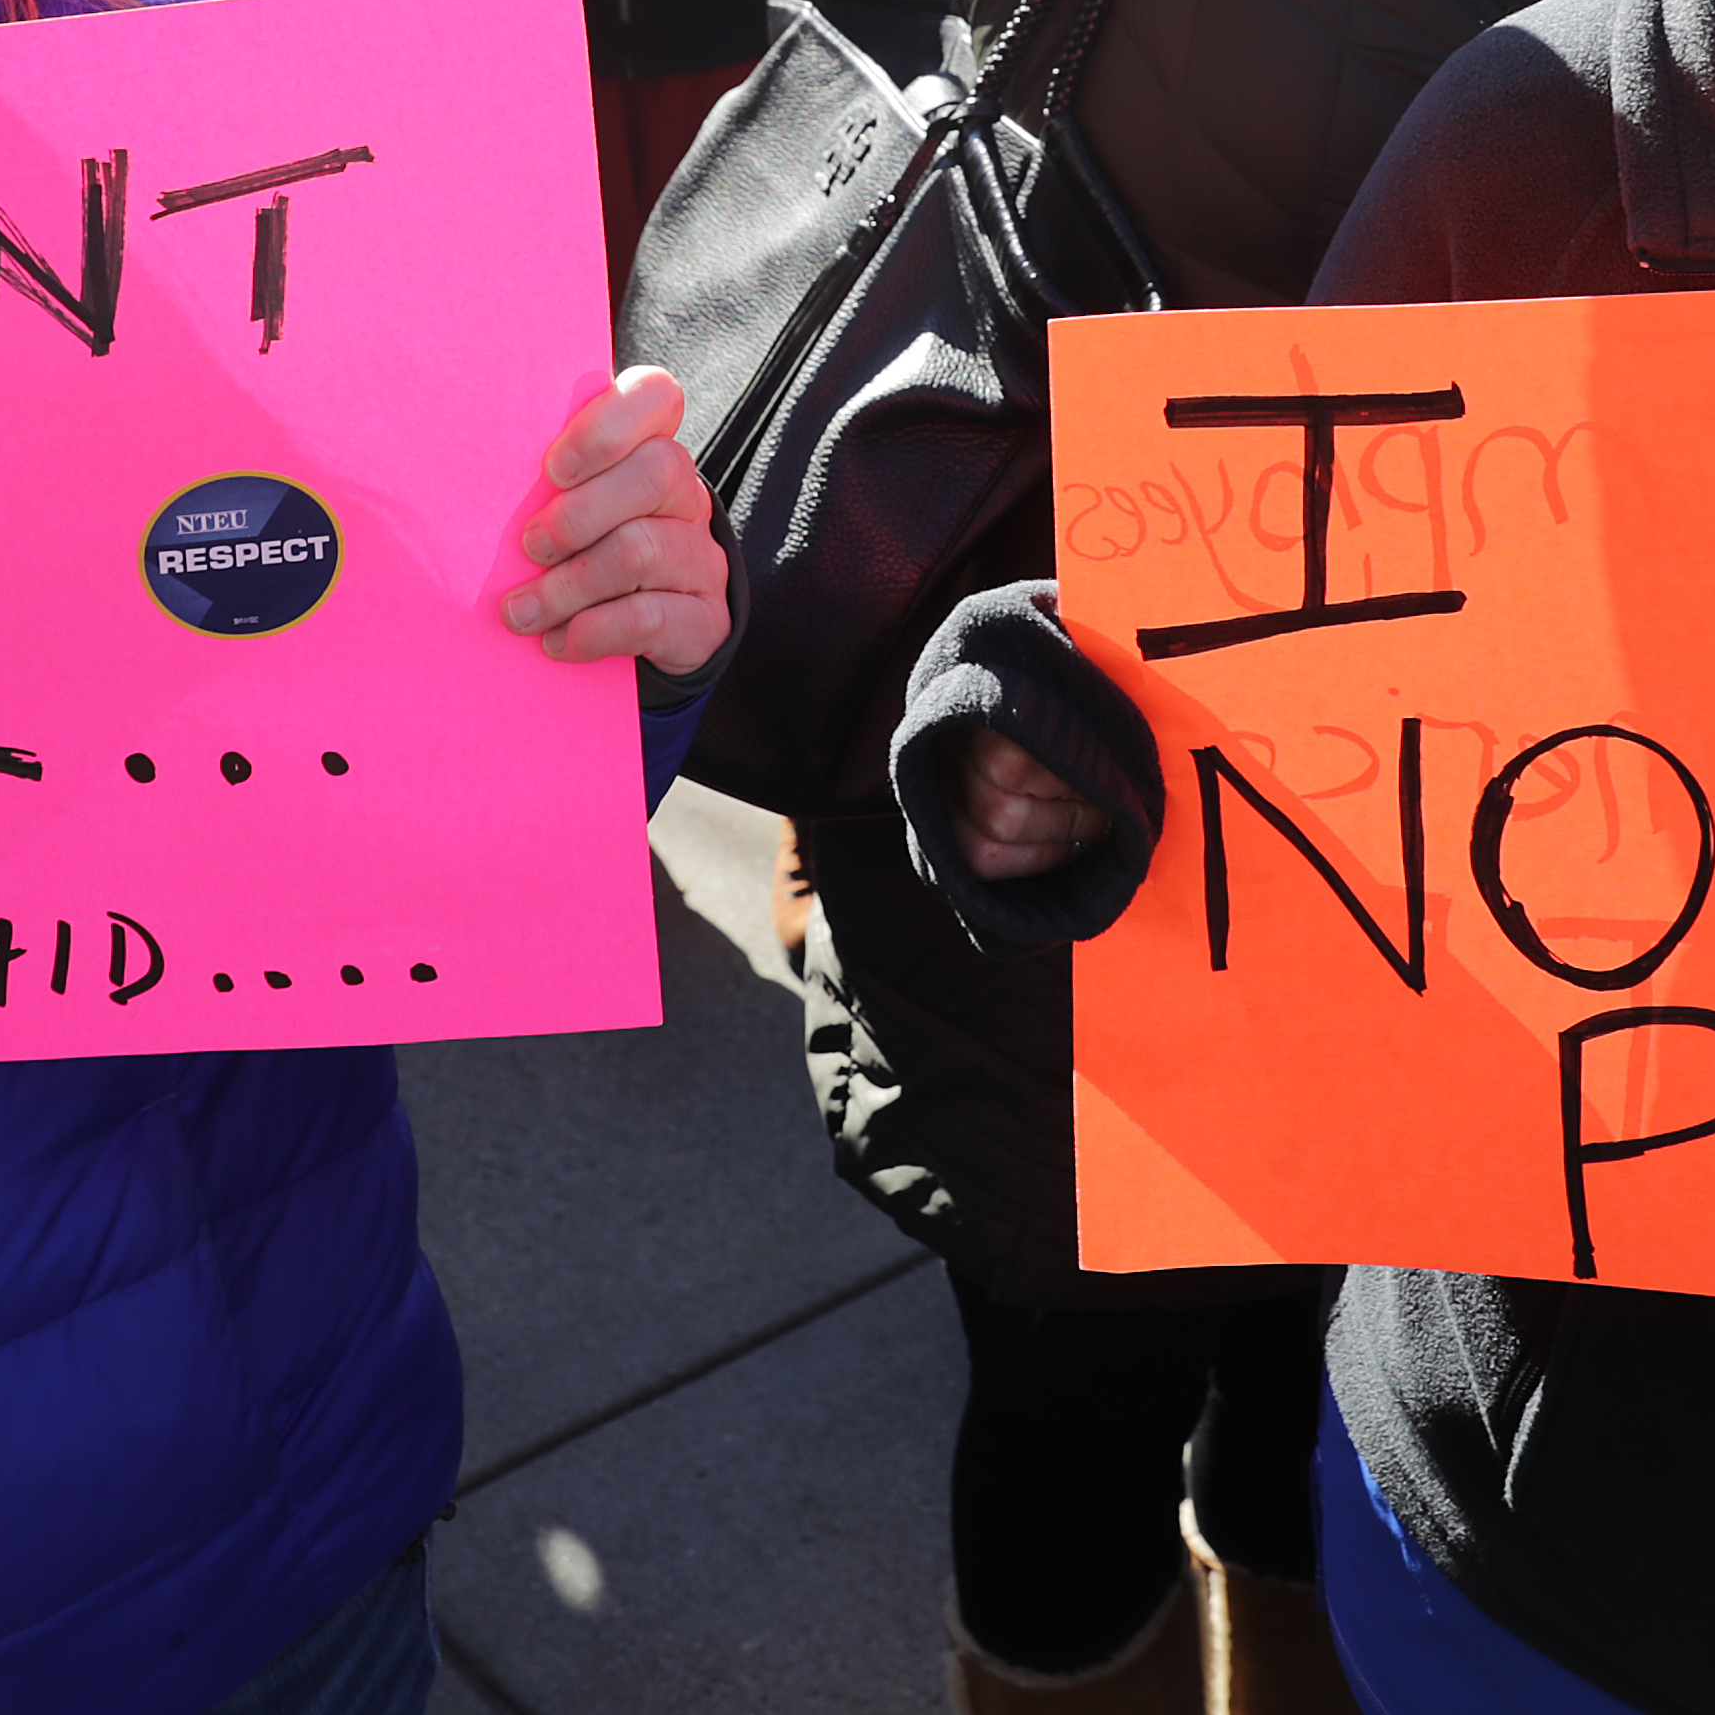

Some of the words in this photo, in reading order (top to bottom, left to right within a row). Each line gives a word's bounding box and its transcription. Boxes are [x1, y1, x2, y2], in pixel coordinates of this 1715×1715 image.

[176, 509, 249, 535] NTEU
[1135, 382, 1467, 662] I
[158, 535, 331, 575] RESPECT
